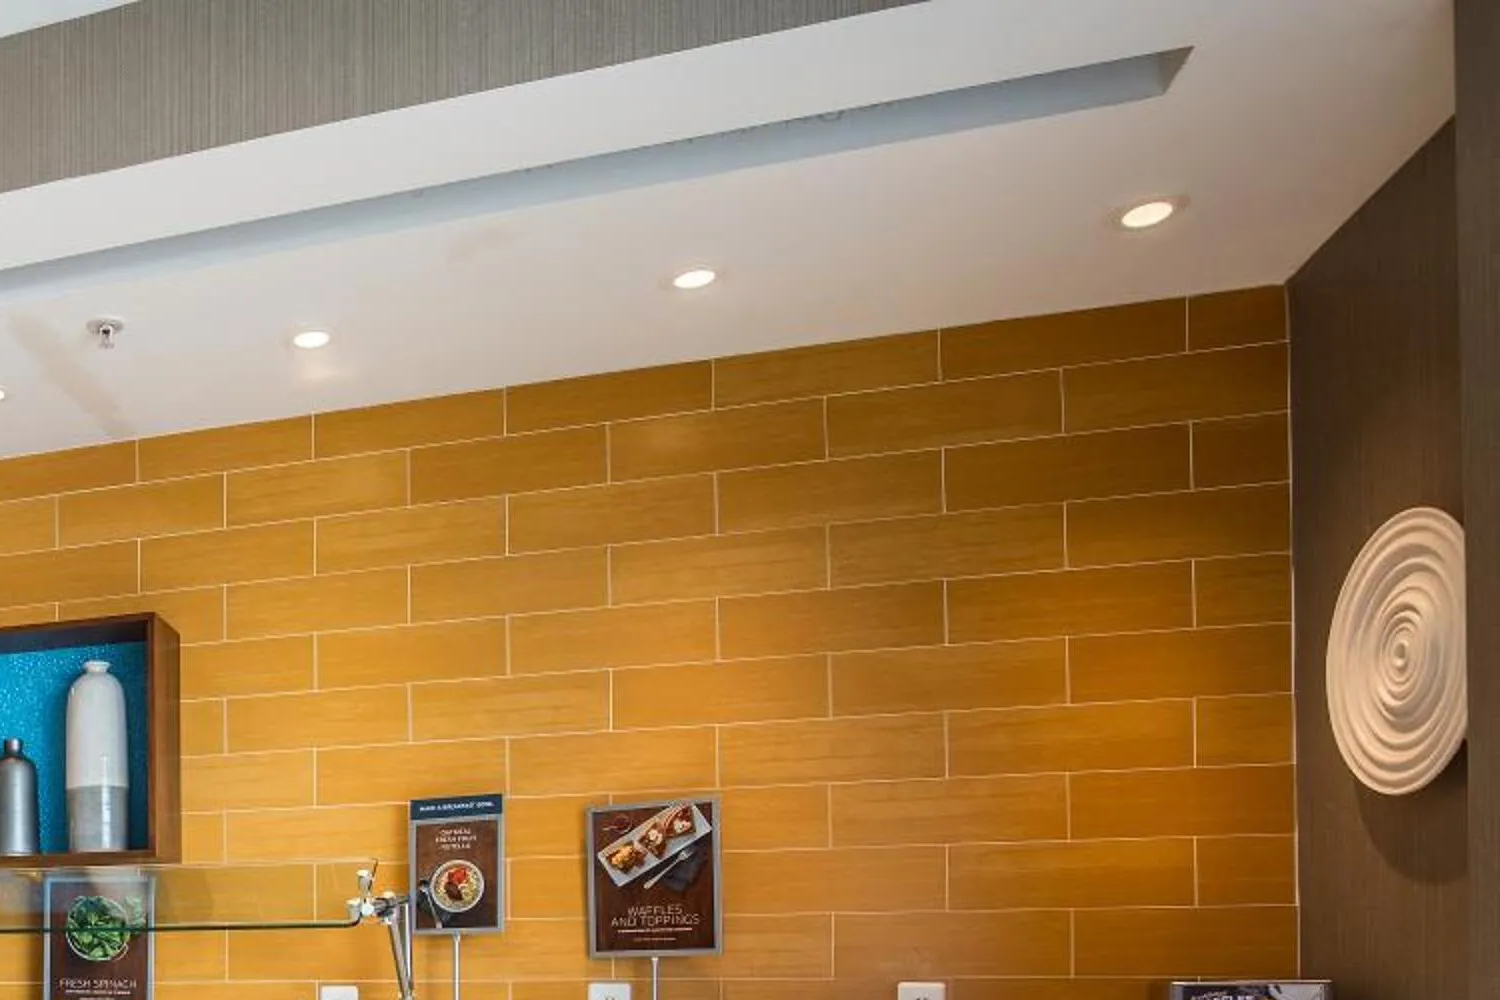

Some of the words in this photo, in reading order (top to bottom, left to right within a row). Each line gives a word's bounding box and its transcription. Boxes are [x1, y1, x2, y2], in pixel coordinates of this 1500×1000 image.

[627, 904, 683, 917] WAFFLES
[611, 916, 637, 928] AND
[640, 913, 700, 927] TOPPINGS
[60, 978, 91, 990] FRESH
[93, 979, 137, 989] SPINACH
